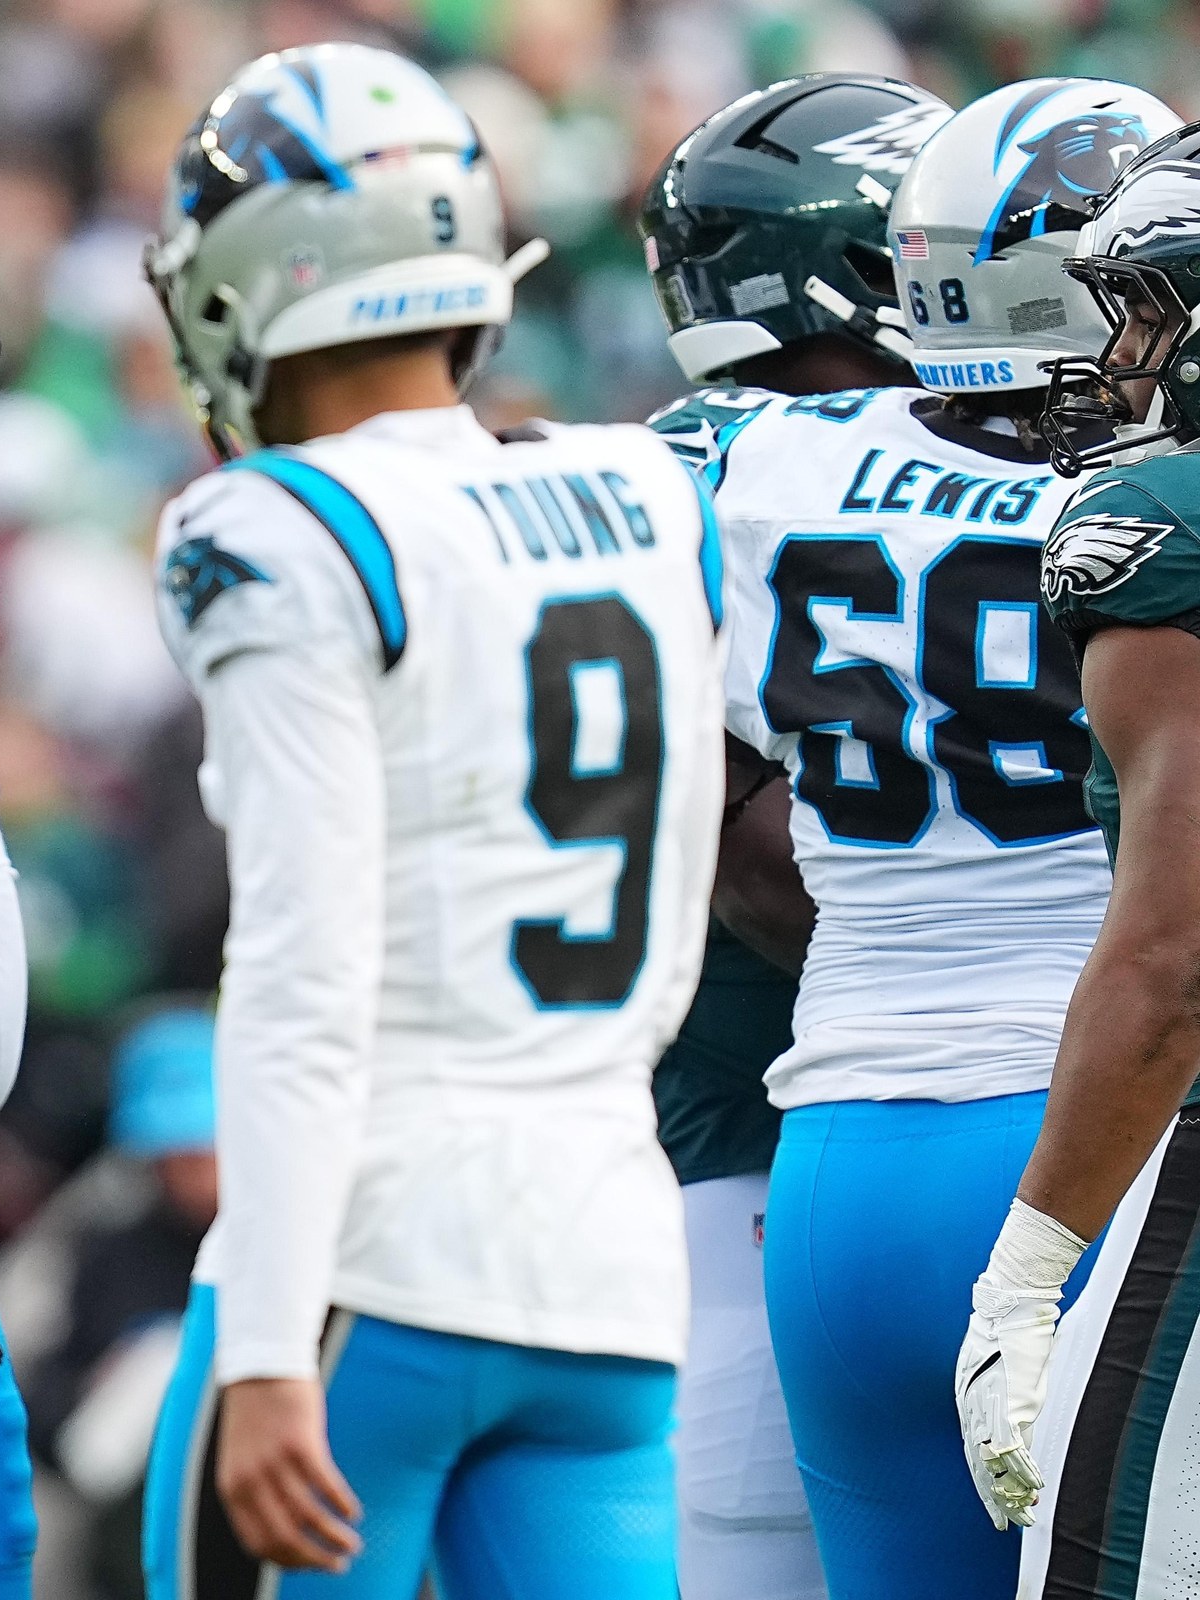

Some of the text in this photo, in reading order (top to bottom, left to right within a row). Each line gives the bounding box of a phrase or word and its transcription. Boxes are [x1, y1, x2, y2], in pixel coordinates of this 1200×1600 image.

[430, 197, 456, 244] 9
[907, 277, 970, 326] 68
[459, 471, 656, 564] YOUNG
[838, 448, 1056, 526] LEWIS
[759, 533, 1102, 848] 68
[509, 590, 666, 1013] 9
